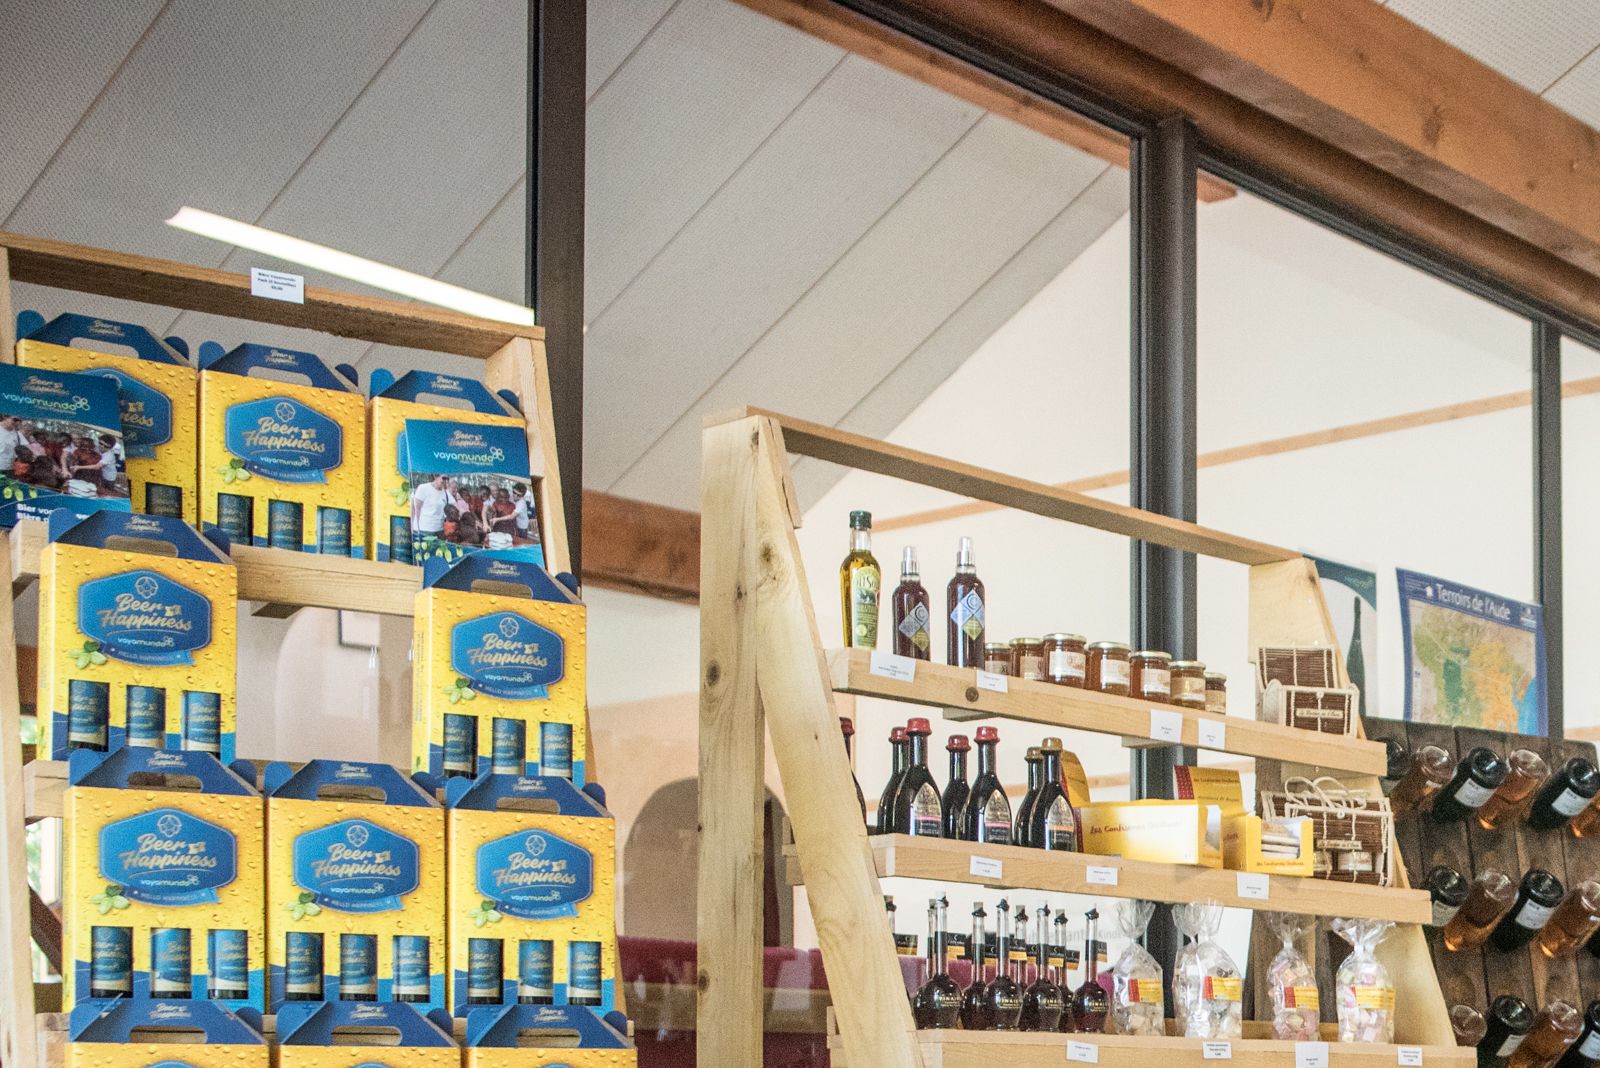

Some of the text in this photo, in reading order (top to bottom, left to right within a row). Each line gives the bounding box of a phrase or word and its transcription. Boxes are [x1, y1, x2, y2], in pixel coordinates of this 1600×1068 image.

[2, 393, 76, 410] vayamundo
[258, 416, 300, 435] Beer
[242, 429, 326, 452] Happiness
[433, 451, 494, 462] vayamundo
[16, 503, 36, 513] Bier
[115, 593, 163, 614] Beer
[1436, 583, 1511, 620] Terroirs de l'Aude
[97, 609, 192, 632] Happiness
[483, 633, 522, 651] Beer
[466, 648, 548, 667] Happiness
[137, 833, 186, 853] Beer
[118, 850, 218, 870] Happiness
[328, 843, 375, 863] Beer
[508, 853, 551, 871] Beer
[311, 861, 401, 878] Happiness
[492, 868, 576, 887] Happiness
